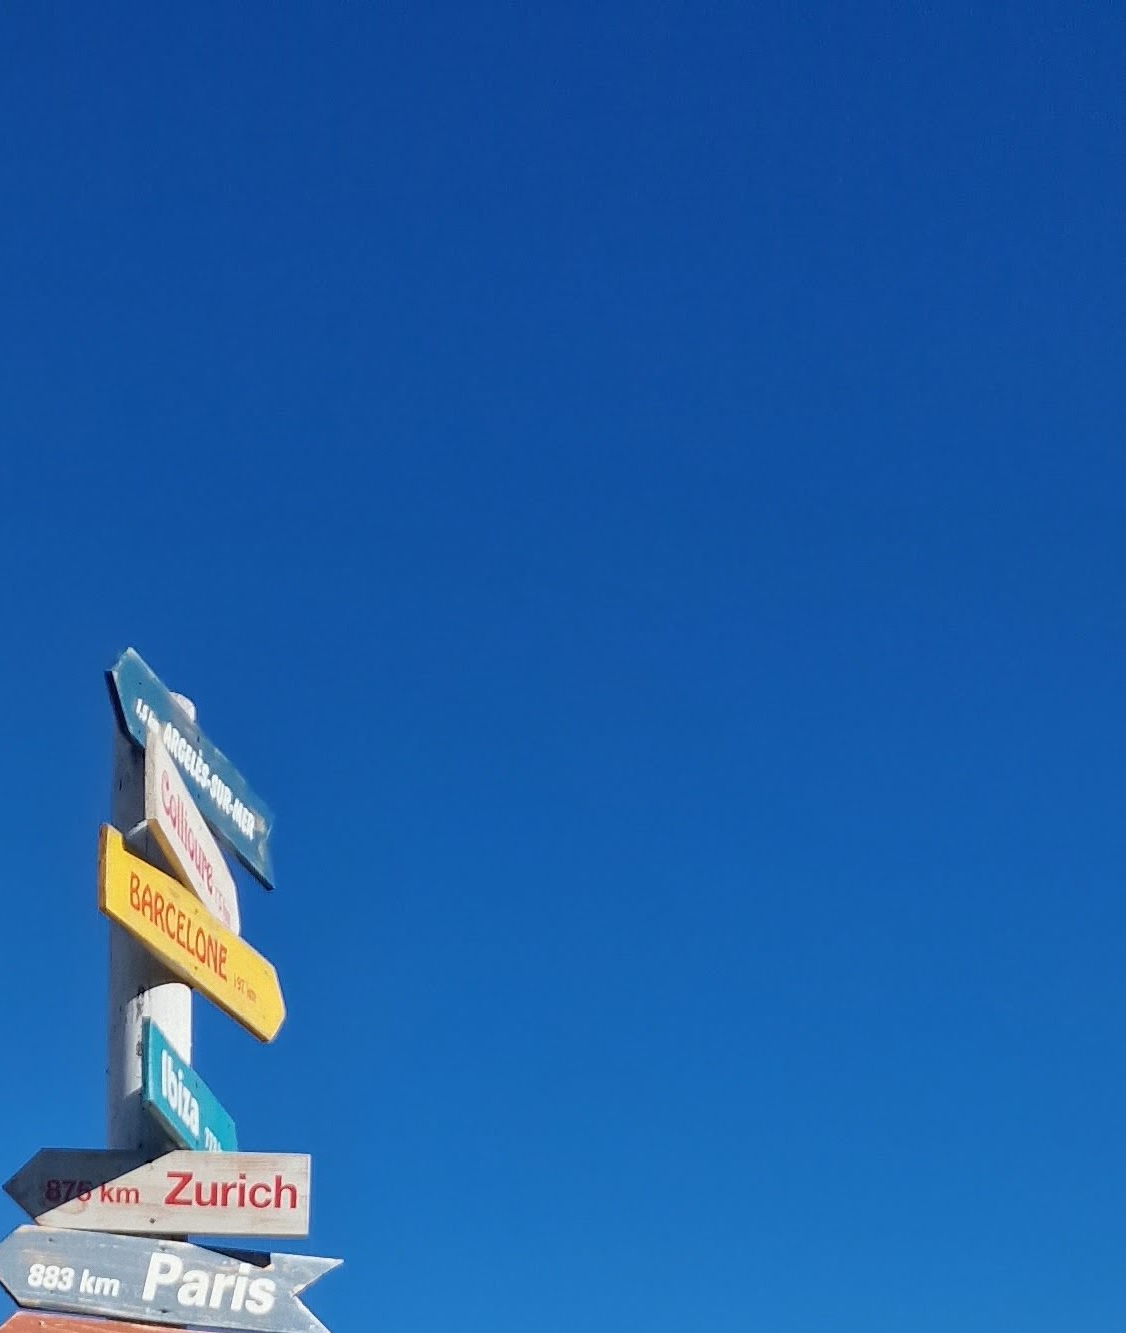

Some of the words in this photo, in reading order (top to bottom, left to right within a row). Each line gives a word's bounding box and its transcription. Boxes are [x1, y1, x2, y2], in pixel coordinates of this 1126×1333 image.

[161, 769, 213, 896] Collioure
[130, 871, 228, 982] BARCELONE
[161, 1049, 199, 1138] Ibiza
[100, 1183, 140, 1204] km
[164, 1170, 298, 1210] Zurich
[27, 1262, 74, 1291] 883
[80, 1268, 120, 1298] km
[142, 1251, 276, 1315] Paris
